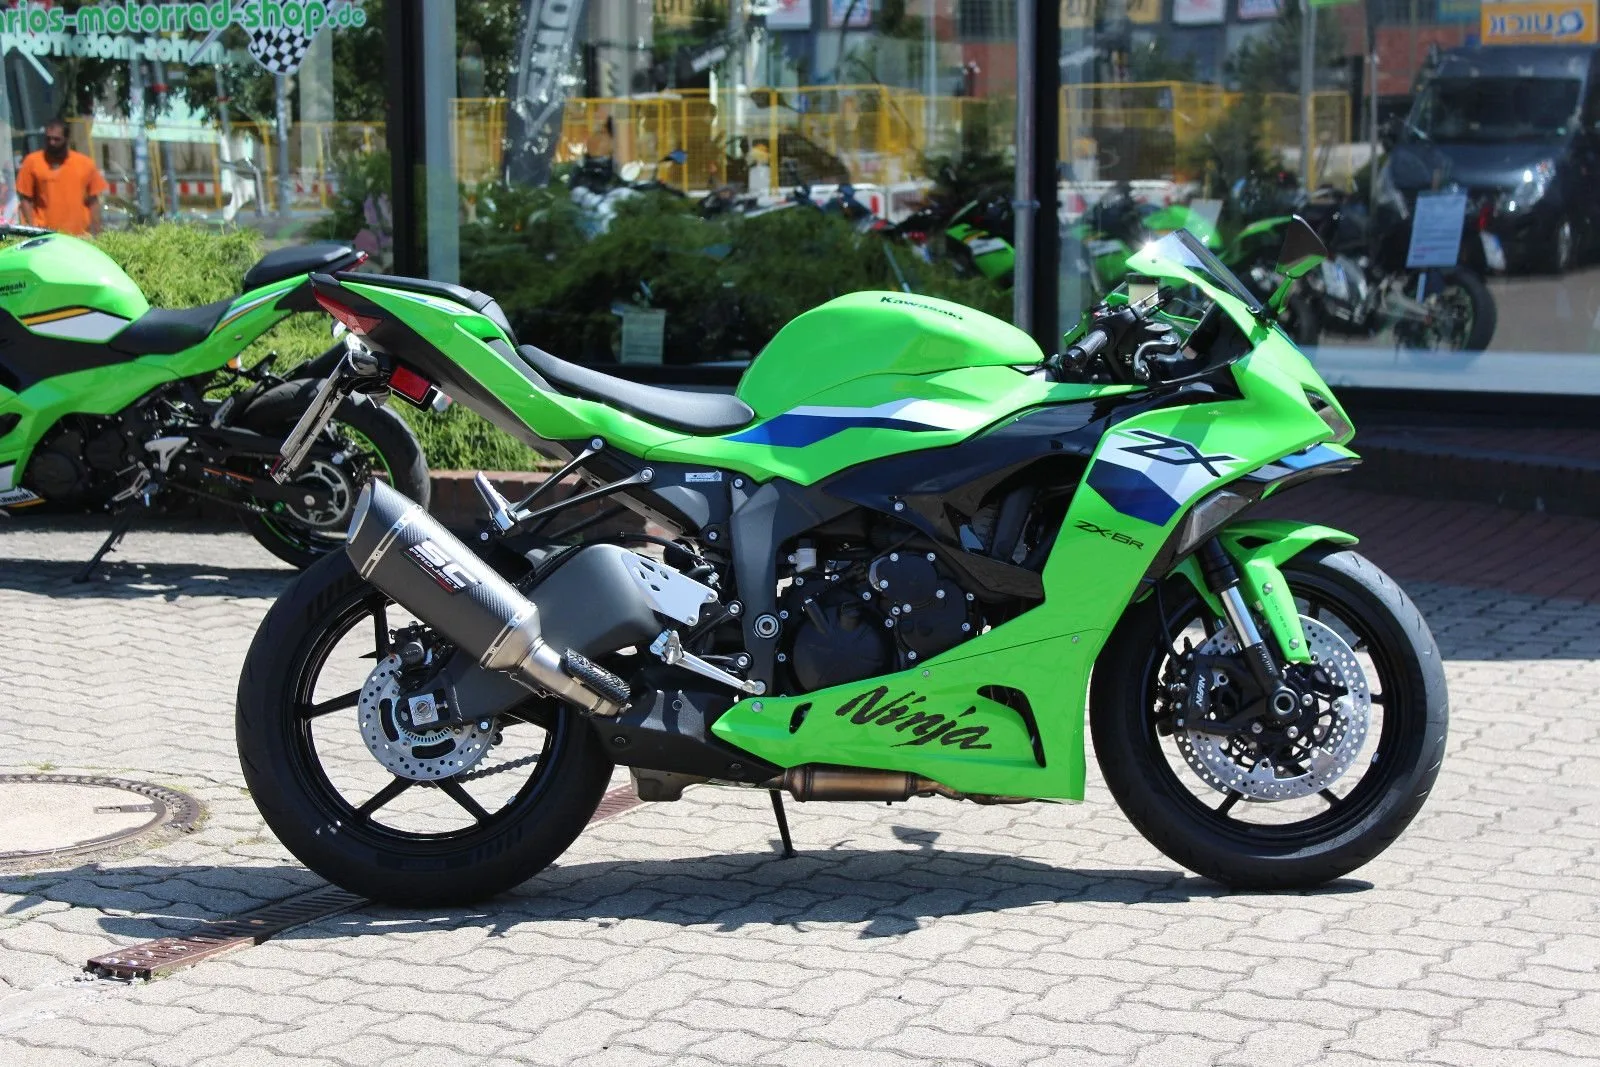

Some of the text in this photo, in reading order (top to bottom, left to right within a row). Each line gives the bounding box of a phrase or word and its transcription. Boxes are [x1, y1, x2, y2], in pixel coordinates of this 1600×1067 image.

[880, 296, 963, 320] Kawasaki
[1073, 519, 1145, 550] ZX-6R
[407, 546, 462, 591] PROJECT
[413, 540, 479, 590] SC
[834, 685, 993, 750] Ninja
